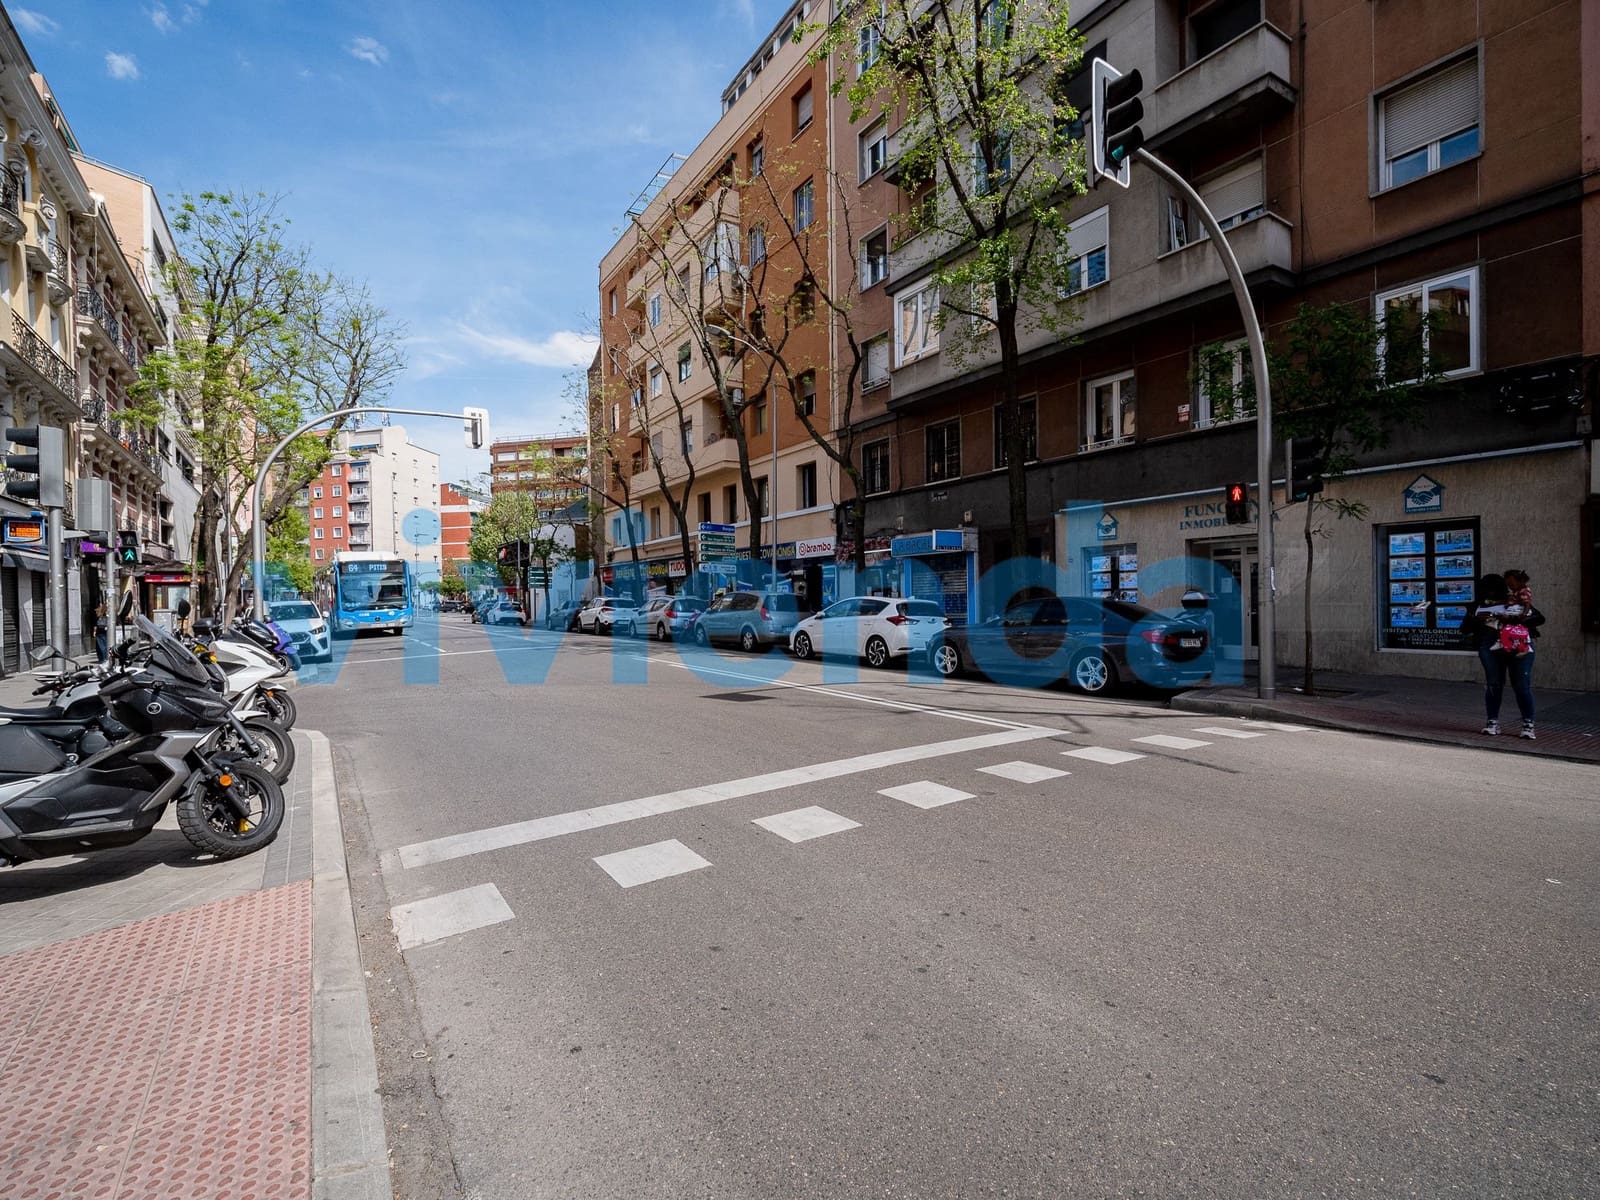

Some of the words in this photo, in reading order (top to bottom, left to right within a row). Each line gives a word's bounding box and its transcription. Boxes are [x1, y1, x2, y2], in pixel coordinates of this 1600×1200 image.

[760, 545, 795, 560] COVAONGA
[806, 543, 831, 554] brembo
[348, 564, 360, 572] 64
[670, 562, 687, 572] TUDO
